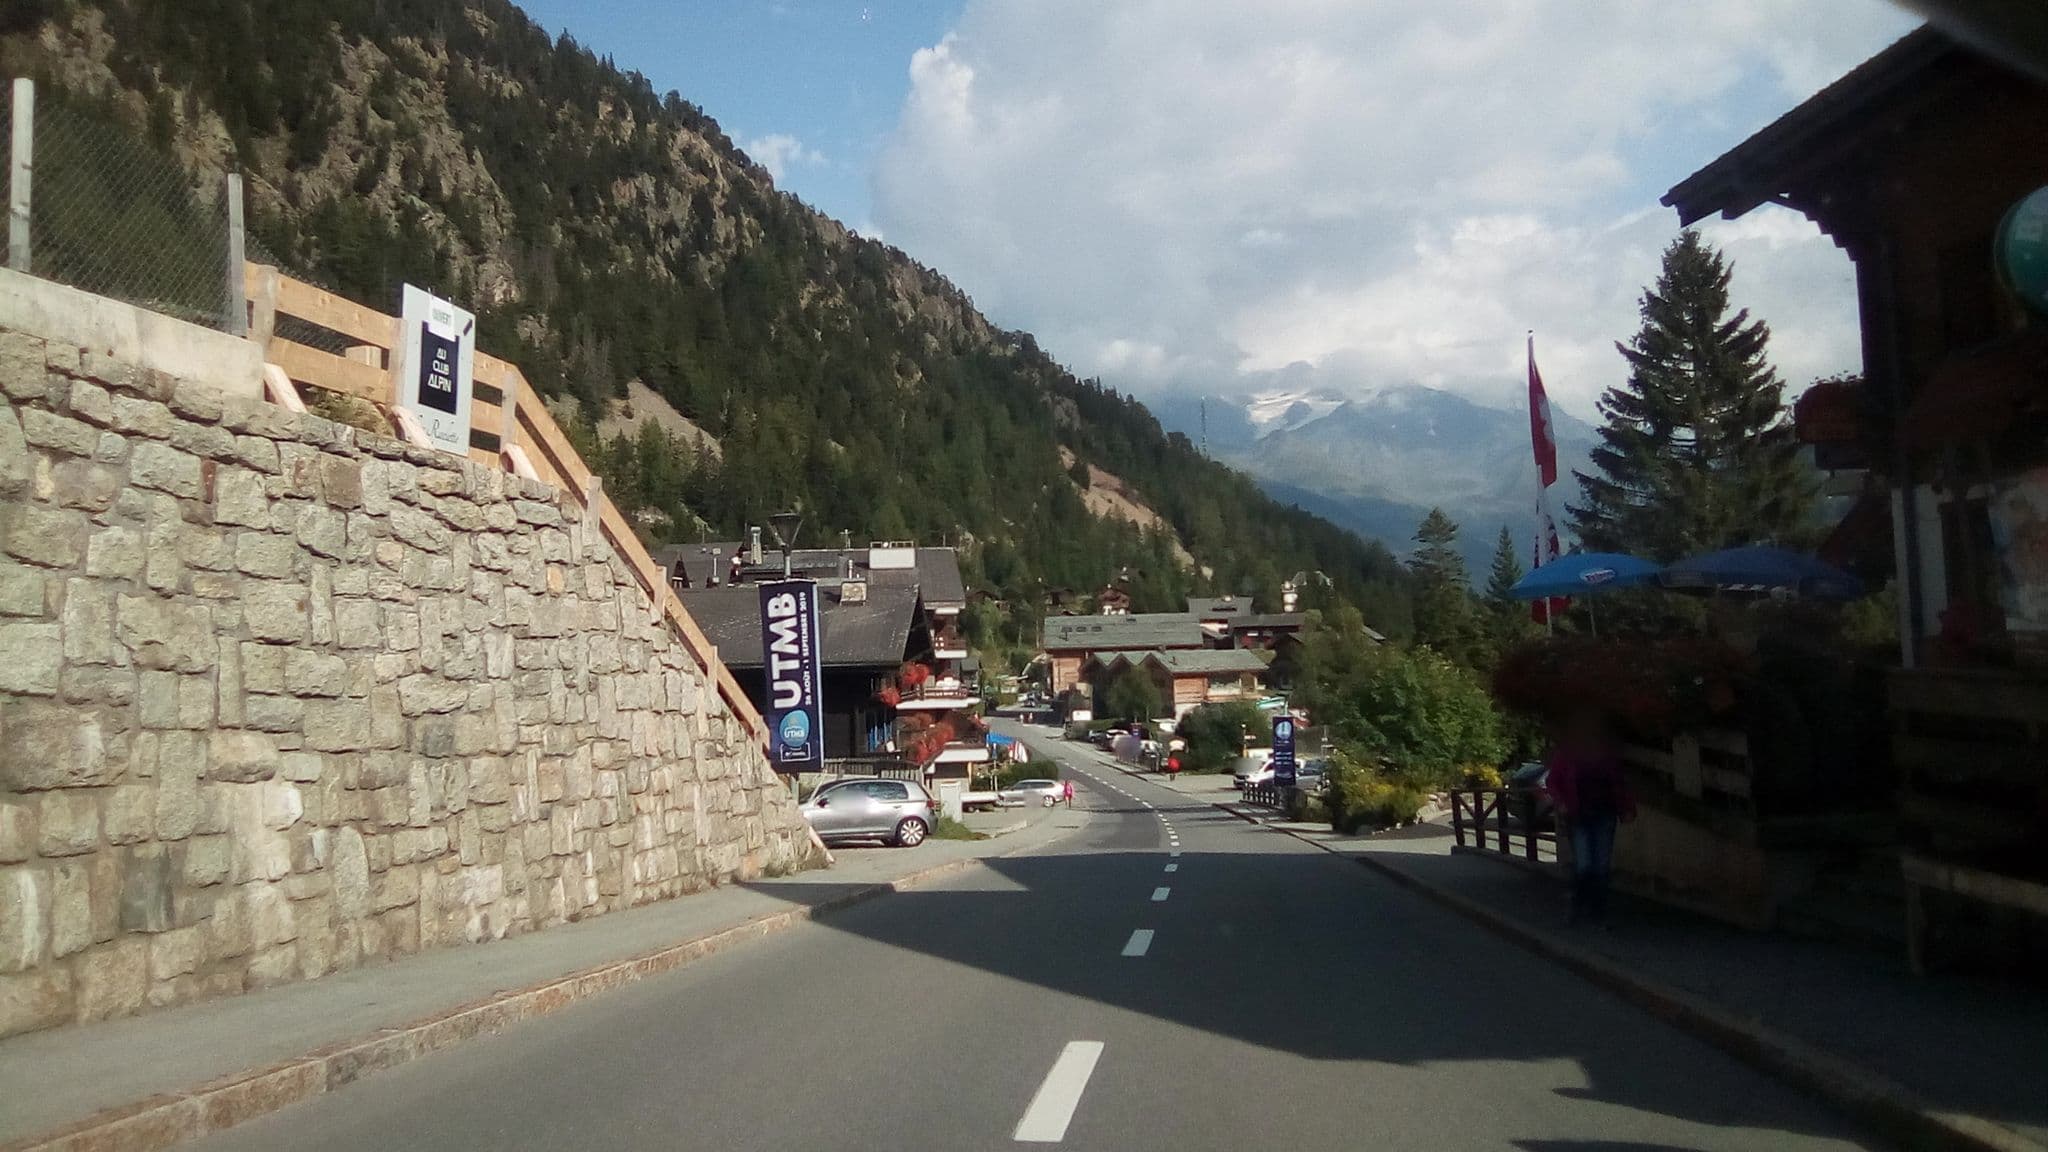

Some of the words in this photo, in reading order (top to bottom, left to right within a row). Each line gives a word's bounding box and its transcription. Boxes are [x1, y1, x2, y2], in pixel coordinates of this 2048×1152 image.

[438, 348, 447, 360] AU
[433, 361, 450, 375] CLUB
[428, 374, 452, 393] ALPIN
[799, 591, 807, 612] 2019
[801, 614, 809, 656] SEPTEMBRE
[768, 594, 802, 708] UTMB
